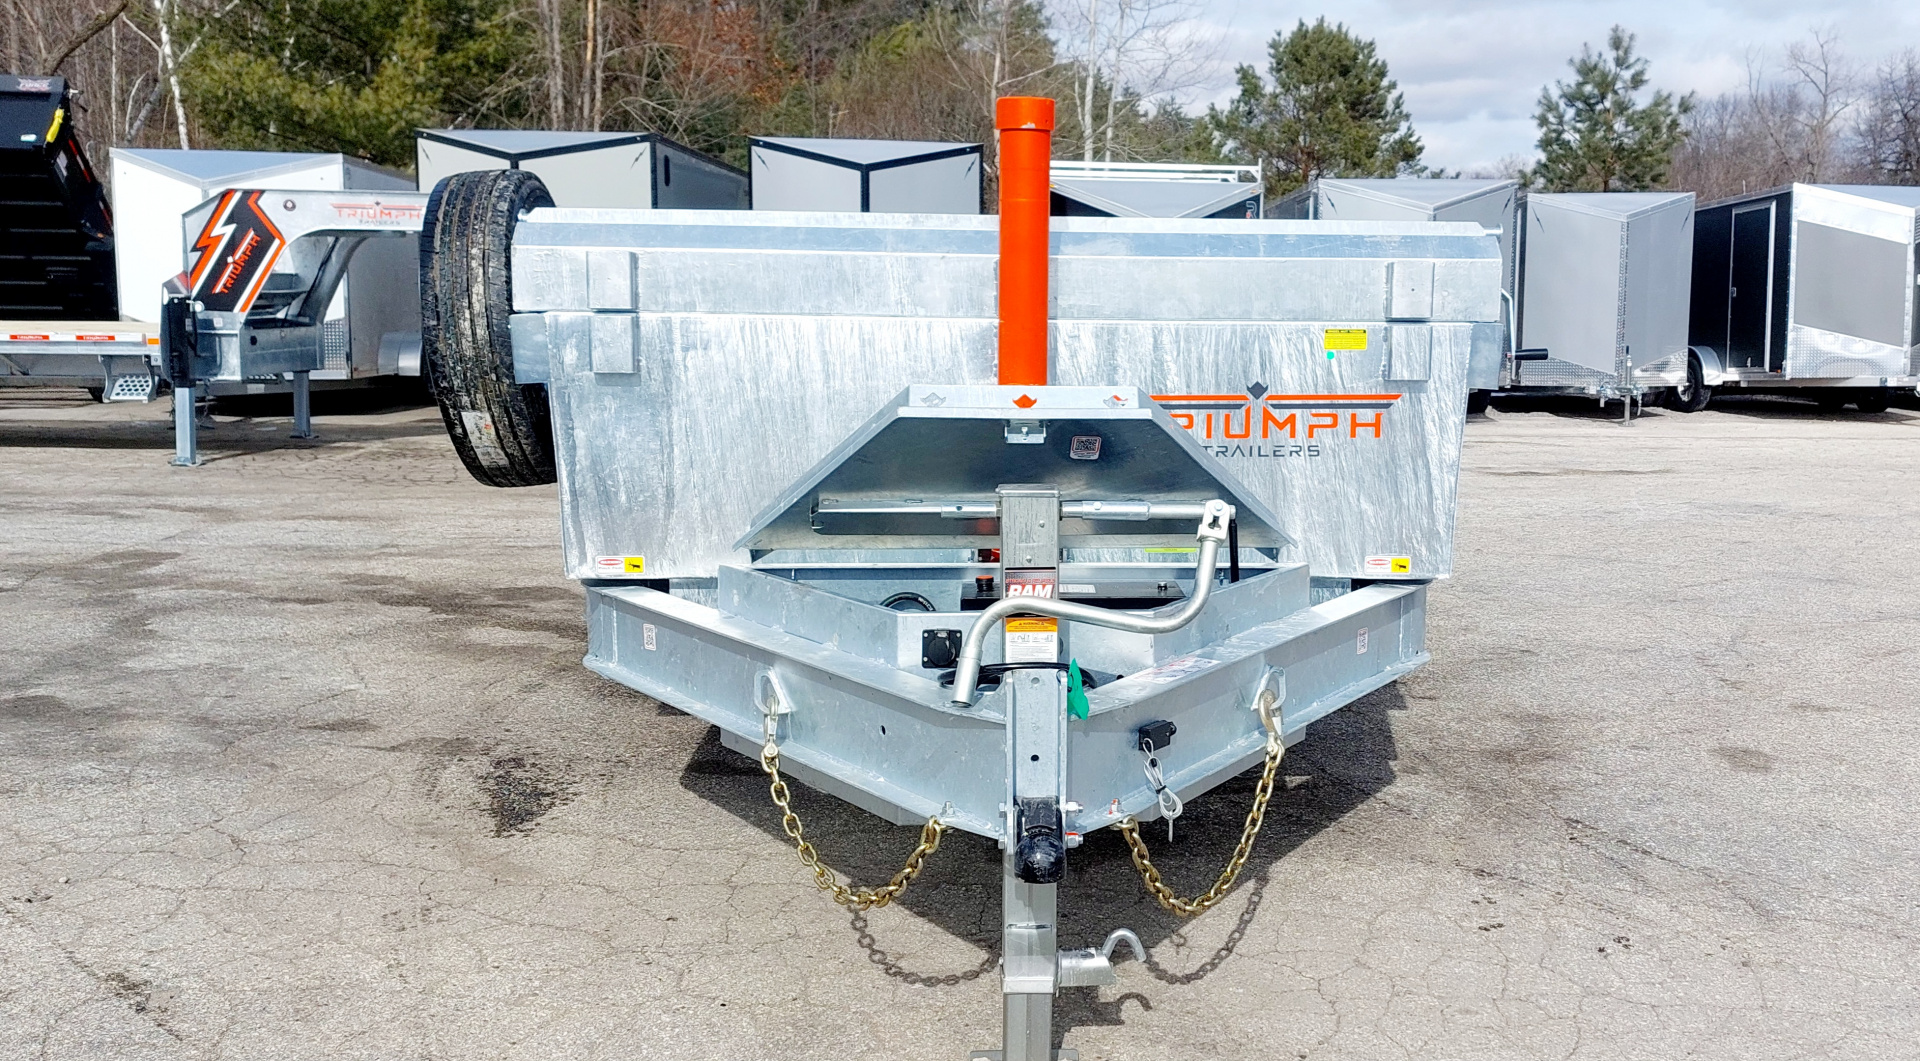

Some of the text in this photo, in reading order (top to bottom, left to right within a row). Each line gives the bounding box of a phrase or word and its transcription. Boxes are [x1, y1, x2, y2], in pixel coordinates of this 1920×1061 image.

[337, 209, 421, 219] TRIUMPH
[219, 234, 261, 294] TRIUMPH
[1202, 444, 1320, 458] TRAILERS
[1007, 584, 1054, 600] RAM
